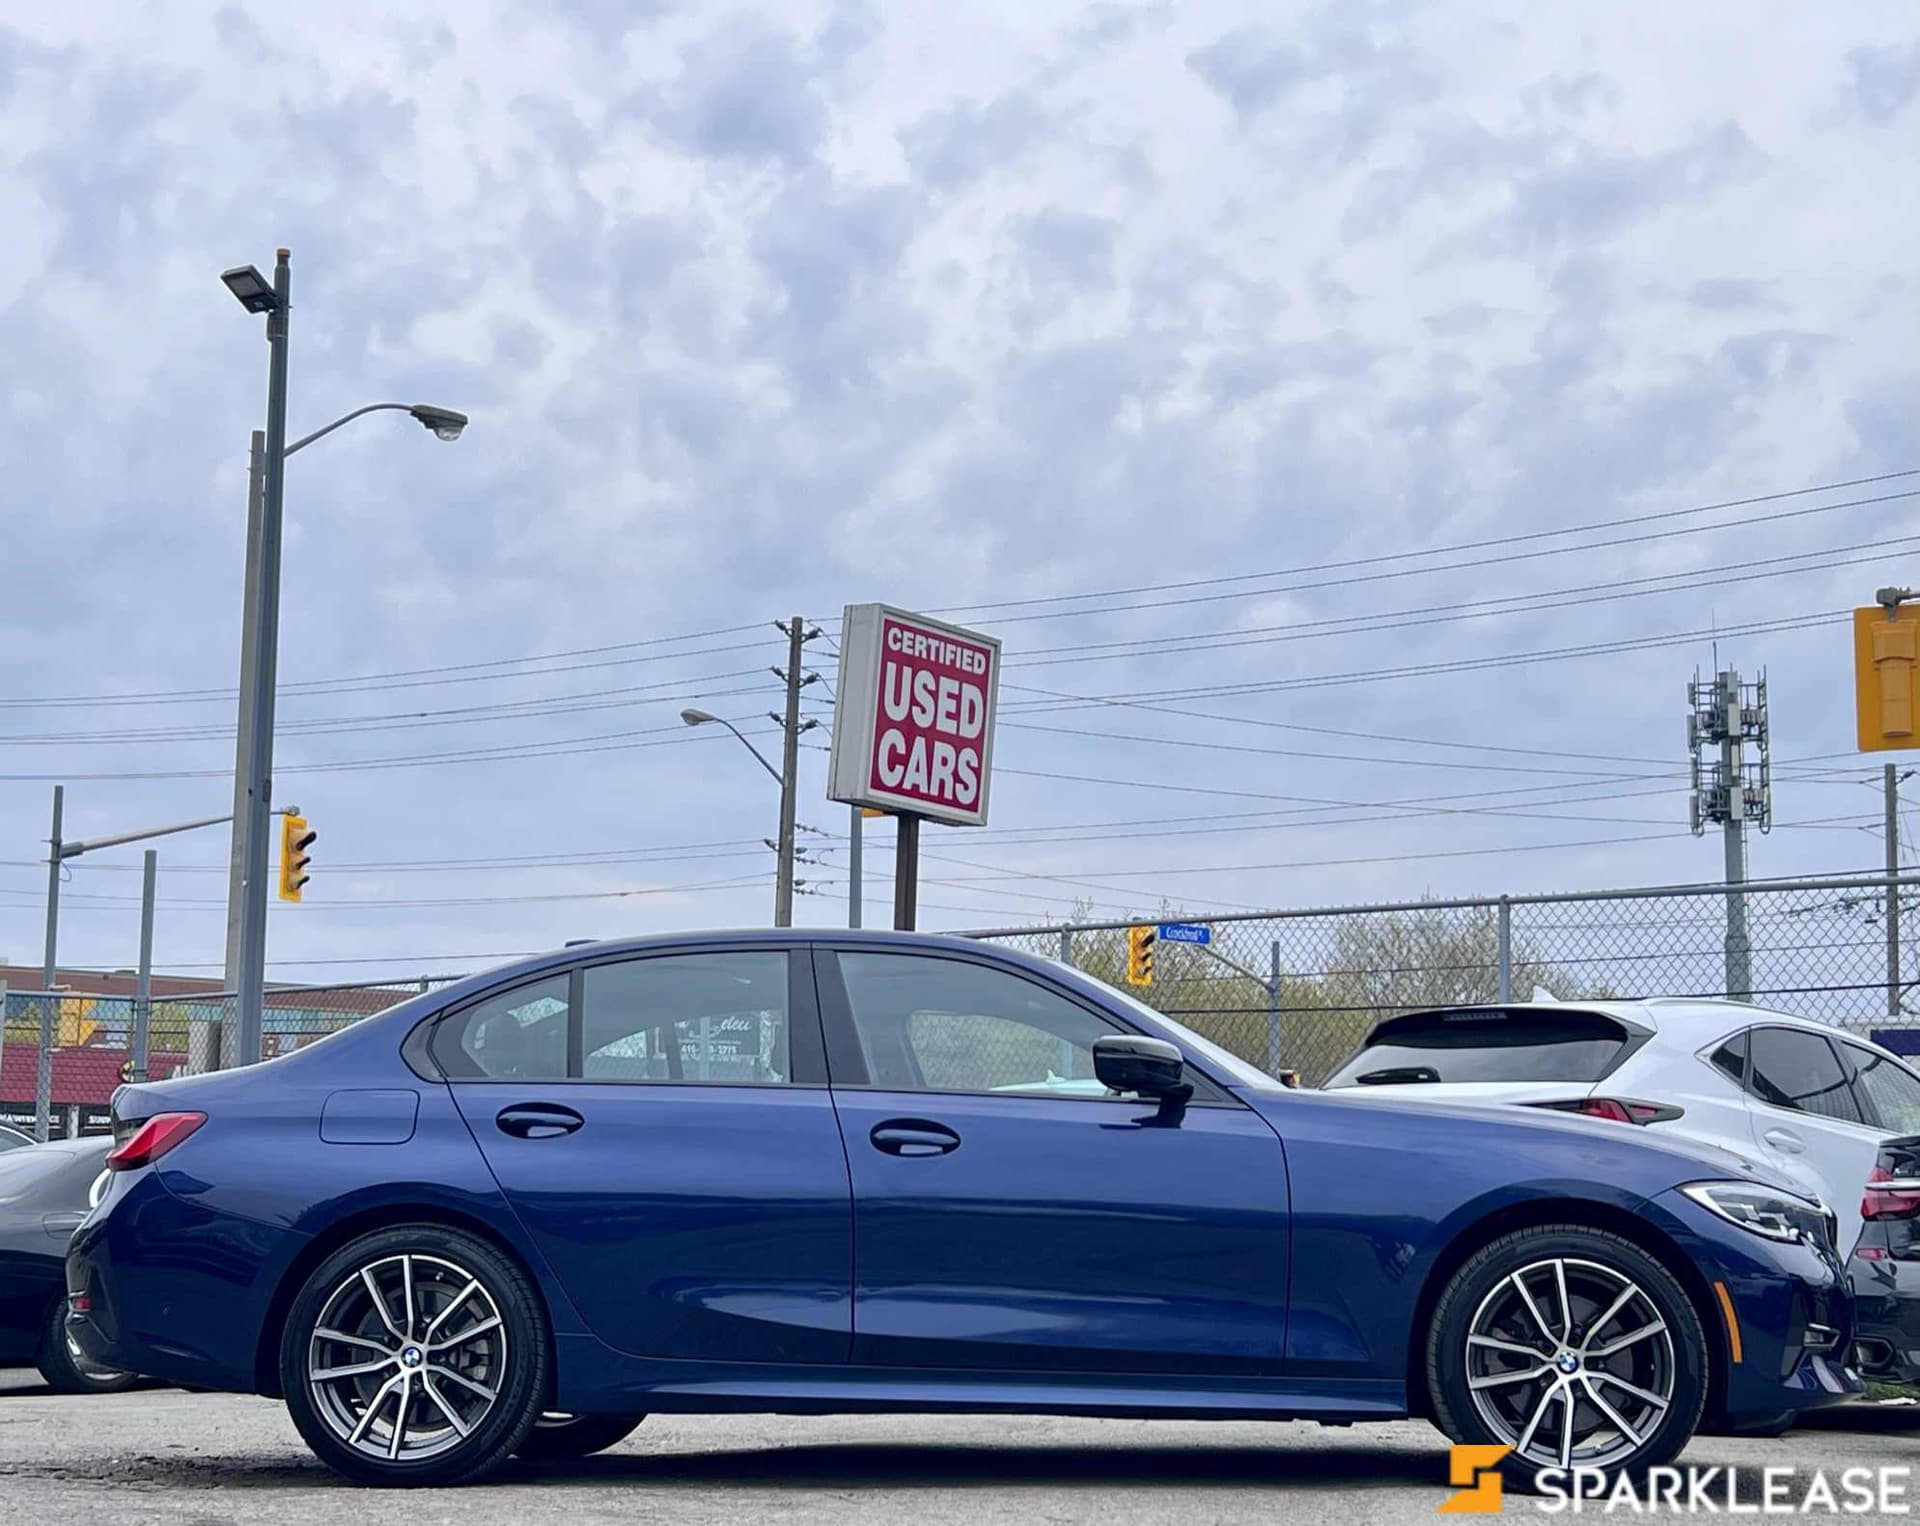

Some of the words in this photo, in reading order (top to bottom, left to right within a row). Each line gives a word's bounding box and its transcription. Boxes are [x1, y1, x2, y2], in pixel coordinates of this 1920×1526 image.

[887, 627, 986, 675] CERTIFIED
[884, 661, 984, 739] USED
[878, 728, 979, 805] CARS
